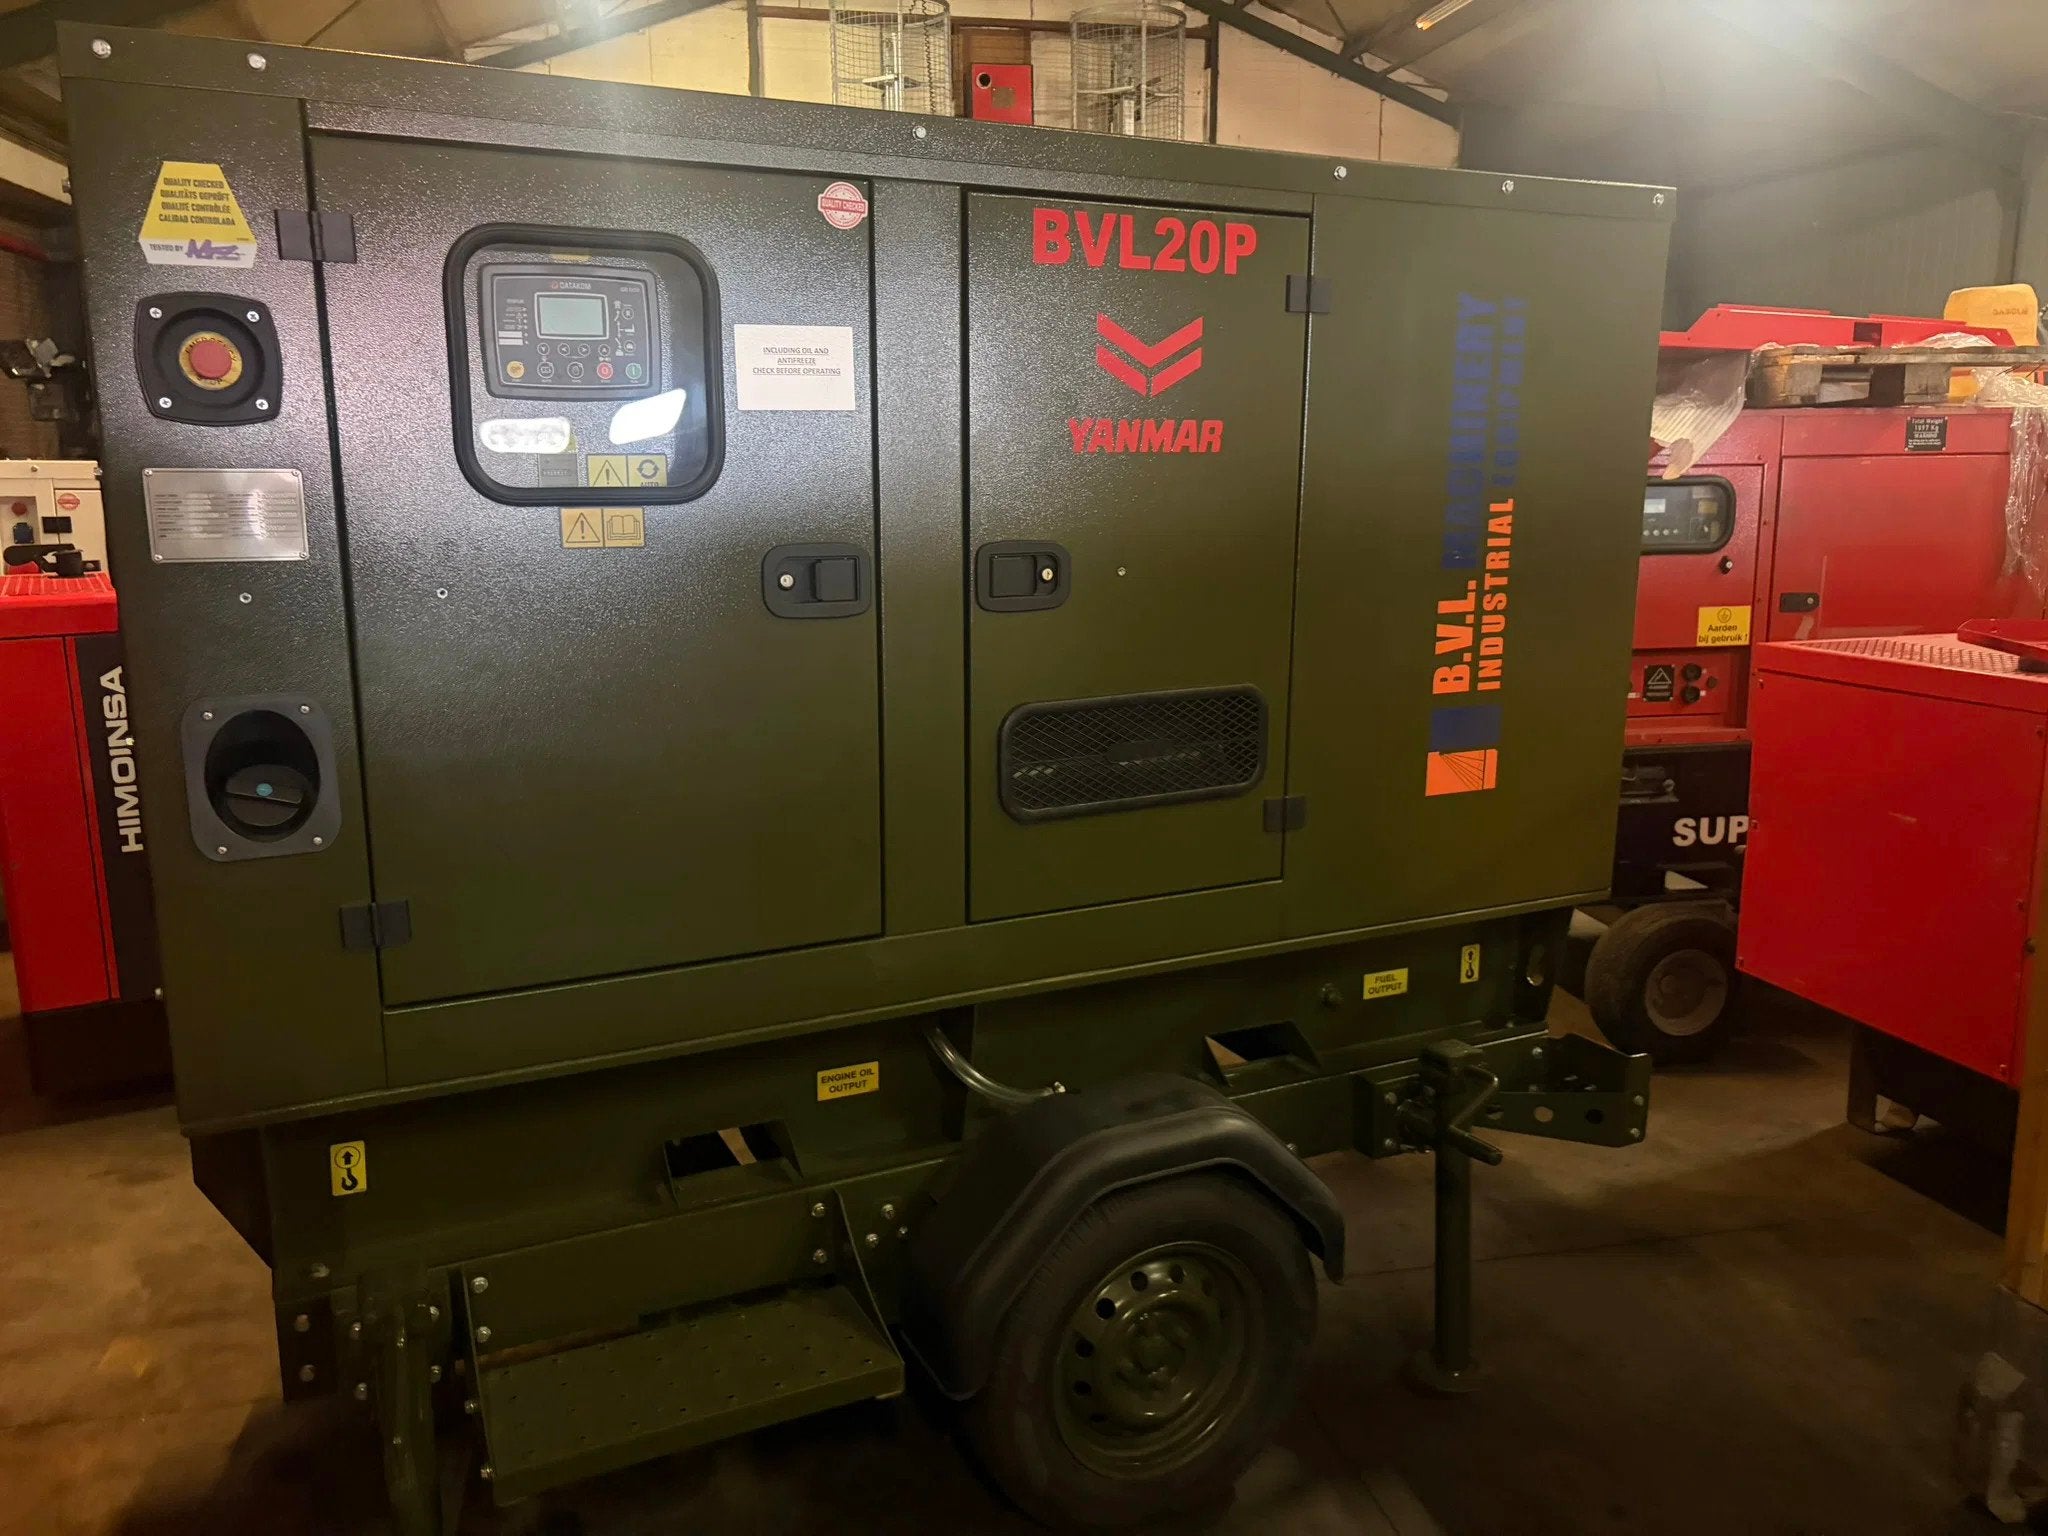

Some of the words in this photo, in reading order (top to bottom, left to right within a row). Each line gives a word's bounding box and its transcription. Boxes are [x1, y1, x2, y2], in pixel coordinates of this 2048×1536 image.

[163, 177, 191, 187] QUALITY
[193, 179, 225, 189] CHECKED
[158, 213, 189, 223] CALIDAD
[190, 215, 236, 226] CONTROLADA
[149, 243, 174, 251] TESTED
[174, 244, 184, 252] BY
[1032, 207, 1257, 275] BVL20P
[763, 346, 801, 354] INCLUDING
[802, 367, 841, 375] OPERATING
[1067, 417, 1224, 454] YANMAR
[1441, 291, 1498, 570] MACHINERY
[1477, 498, 1514, 691] INDUSTRIAL
[1707, 624, 1738, 632] Aarden
[1432, 579, 1477, 695] B.V.L.
[1698, 634, 1709, 644] bij
[1711, 634, 1743, 644] gebruik
[99, 665, 144, 853] HIMOINSA
[1672, 815, 1749, 847] SUP
[1375, 973, 1398, 983] FUEL
[1367, 982, 1403, 995] OUTPUT
[820, 1070, 857, 1084] ENGINE
[859, 1068, 875, 1077] OIL
[829, 1080, 868, 1093] OUTPUT
